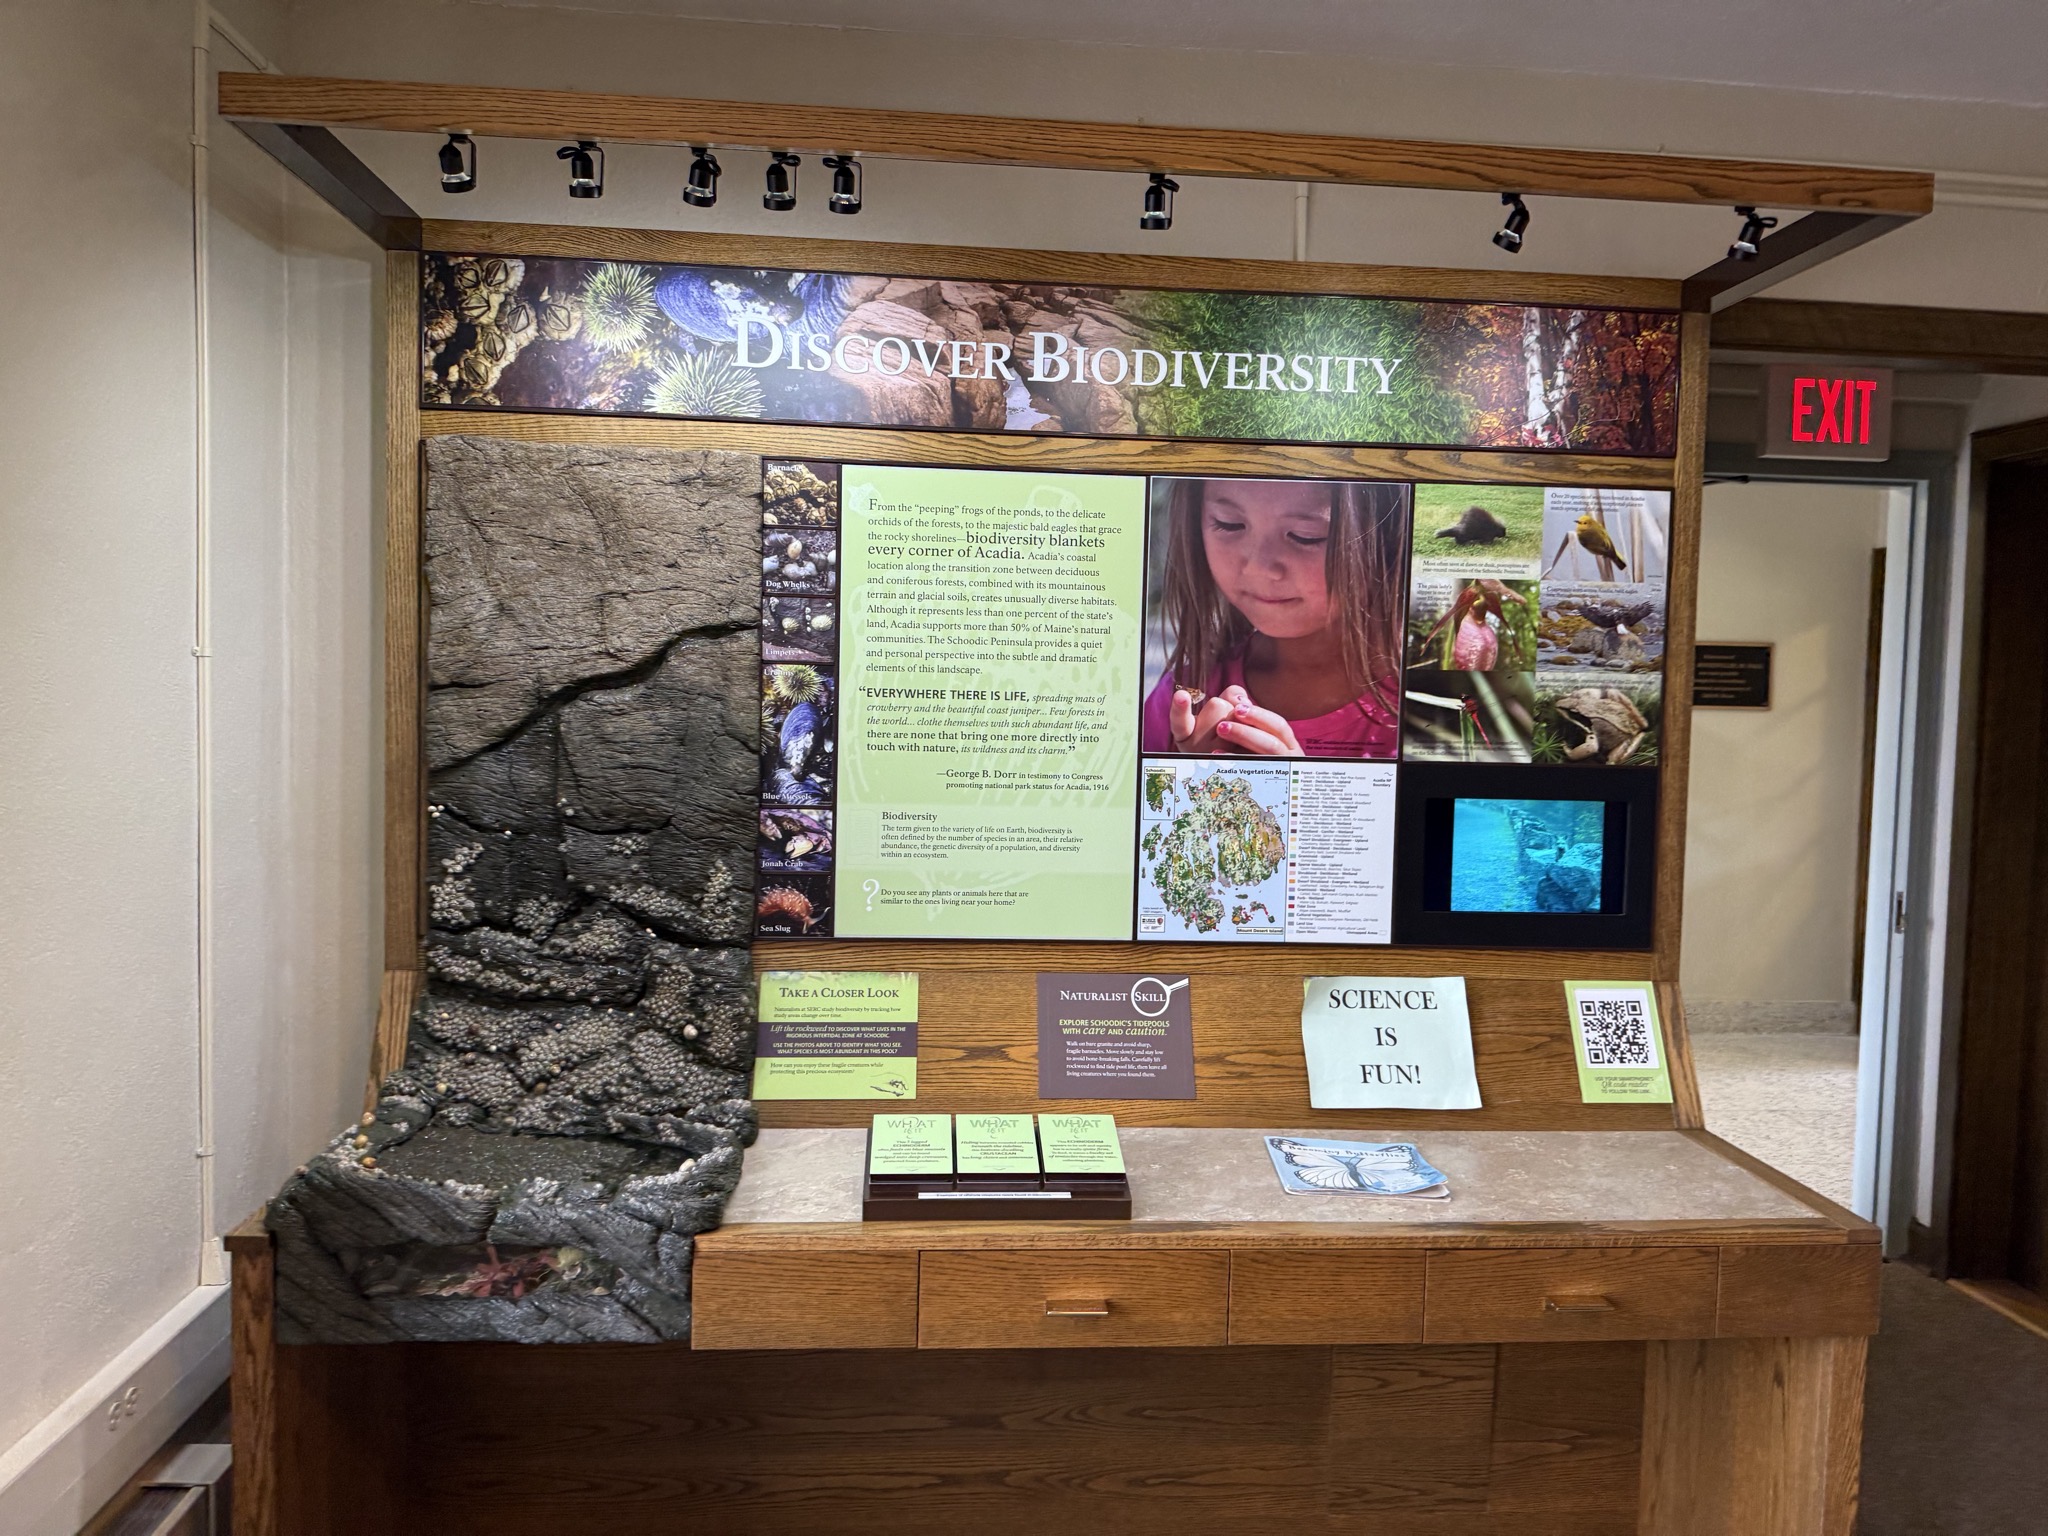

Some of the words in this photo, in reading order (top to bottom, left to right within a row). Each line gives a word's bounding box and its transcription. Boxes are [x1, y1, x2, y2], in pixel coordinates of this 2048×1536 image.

[732, 316, 1016, 381] DISCOVER
[1026, 332, 1404, 395] BIODIVERSITY
[1792, 378, 1877, 445] EXIT
[869, 499, 896, 512] From
[898, 502, 912, 513] the
[914, 503, 959, 517] "peeping"
[961, 504, 984, 518] frogs
[985, 505, 996, 516] of
[997, 506, 1011, 516] the
[1013, 506, 1043, 520] ponds,
[1045, 507, 1054, 518] to
[1056, 508, 1070, 518] the
[1071, 508, 1106, 520] delicate
[868, 517, 901, 527] orchids
[903, 518, 913, 528] of
[914, 518, 929, 528] the
[931, 519, 963, 530] forests,
[964, 520, 974, 530] to
[976, 520, 990, 530] the
[992, 521, 1028, 534] majestic
[1029, 522, 1049, 532] bald
[1050, 522, 1078, 535] eagles
[1079, 523, 1096, 534] that
[1097, 527, 1122, 537] grace
[868, 531, 882, 541] the
[884, 532, 909, 545] rocky
[1049, 536, 1105, 548] blankets
[868, 546, 905, 559] every
[908, 547, 954, 558] corner
[957, 546, 971, 558] of
[974, 546, 1024, 560] Acadia.
[1027, 548, 1064, 561] Acadia's
[1066, 549, 1096, 562] coastal
[766, 580, 782, 589] Dog
[783, 581, 811, 589] Whelks
[866, 634, 925, 644] communities.
[926, 635, 945, 645] The
[946, 636, 988, 646] Schoodic
[990, 636, 1033, 647] Peninsula
[1034, 638, 1072, 651] provides
[1080, 639, 1102, 651] quiet
[766, 648, 795, 657] Limpets
[949, 689, 987, 701] THERE
[990, 690, 1000, 701] IS
[1004, 690, 1029, 703] LIFE,
[1032, 690, 1073, 705] spreading
[1074, 691, 1095, 703] mats
[1096, 692, 1106, 703] of
[866, 703, 912, 716] crowberry
[913, 704, 931, 713] and
[932, 704, 946, 713] the
[946, 704, 985, 714] beautiful
[986, 705, 1009, 715] coast
[1049, 706, 1067, 716] Few
[1066, 707, 1095, 716] forests
[1096, 707, 1105, 716] in
[981, 770, 991, 779] B.
[993, 770, 1017, 779] Dorr
[1018, 770, 1026, 779] in
[1027, 770, 1061, 782] testimony
[1062, 771, 1070, 780] to
[1070, 771, 1103, 783] Congress
[946, 781, 983, 791] promoting
[984, 782, 1014, 790] national
[1014, 782, 1031, 792] park
[1032, 782, 1053, 790] status
[1065, 783, 1092, 792] Acadia,
[1092, 783, 1109, 791] 1916
[882, 812, 937, 823] Biodiversity
[881, 824, 895, 832] The
[912, 825, 931, 835] given
[931, 825, 939, 833] to
[940, 825, 951, 833] the
[952, 825, 975, 835] variety
[1006, 826, 1026, 835] Earth,
[1027, 826, 1066, 836] biodiversity
[761, 860, 783, 868] Jonah
[785, 859, 804, 868] Crab
[880, 888, 892, 896] Do
[892, 890, 906, 898] you
[918, 890, 930, 898] any
[931, 889, 952, 899] plants
[961, 889, 987, 897] animals
[988, 889, 1003, 897] here
[774, 925, 791, 934] Slug
[779, 988, 809, 998] TAKE
[812, 989, 819, 998] A
[821, 988, 864, 998] CLOSER
[867, 988, 899, 998] LOOK
[1060, 990, 1128, 1001] NATURALIST
[1134, 991, 1166, 1002] SKILL
[1328, 988, 1438, 1010] SCIENCE
[1059, 1018, 1089, 1026] EXPLORE
[1090, 1018, 1132, 1027] SCHOODIC'S
[1132, 1019, 1170, 1027] TIDEPOOLS
[771, 1025, 783, 1033] Lift
[1062, 1027, 1081, 1035] WITH
[1082, 1027, 1106, 1035] care
[1124, 1028, 1168, 1036] caution.
[1376, 1027, 1397, 1047] IS
[1361, 1064, 1421, 1084] FUN!
[887, 1119, 936, 1128] WHAT
[970, 1119, 1019, 1128] WHAT
[1052, 1119, 1100, 1128] WHAT
